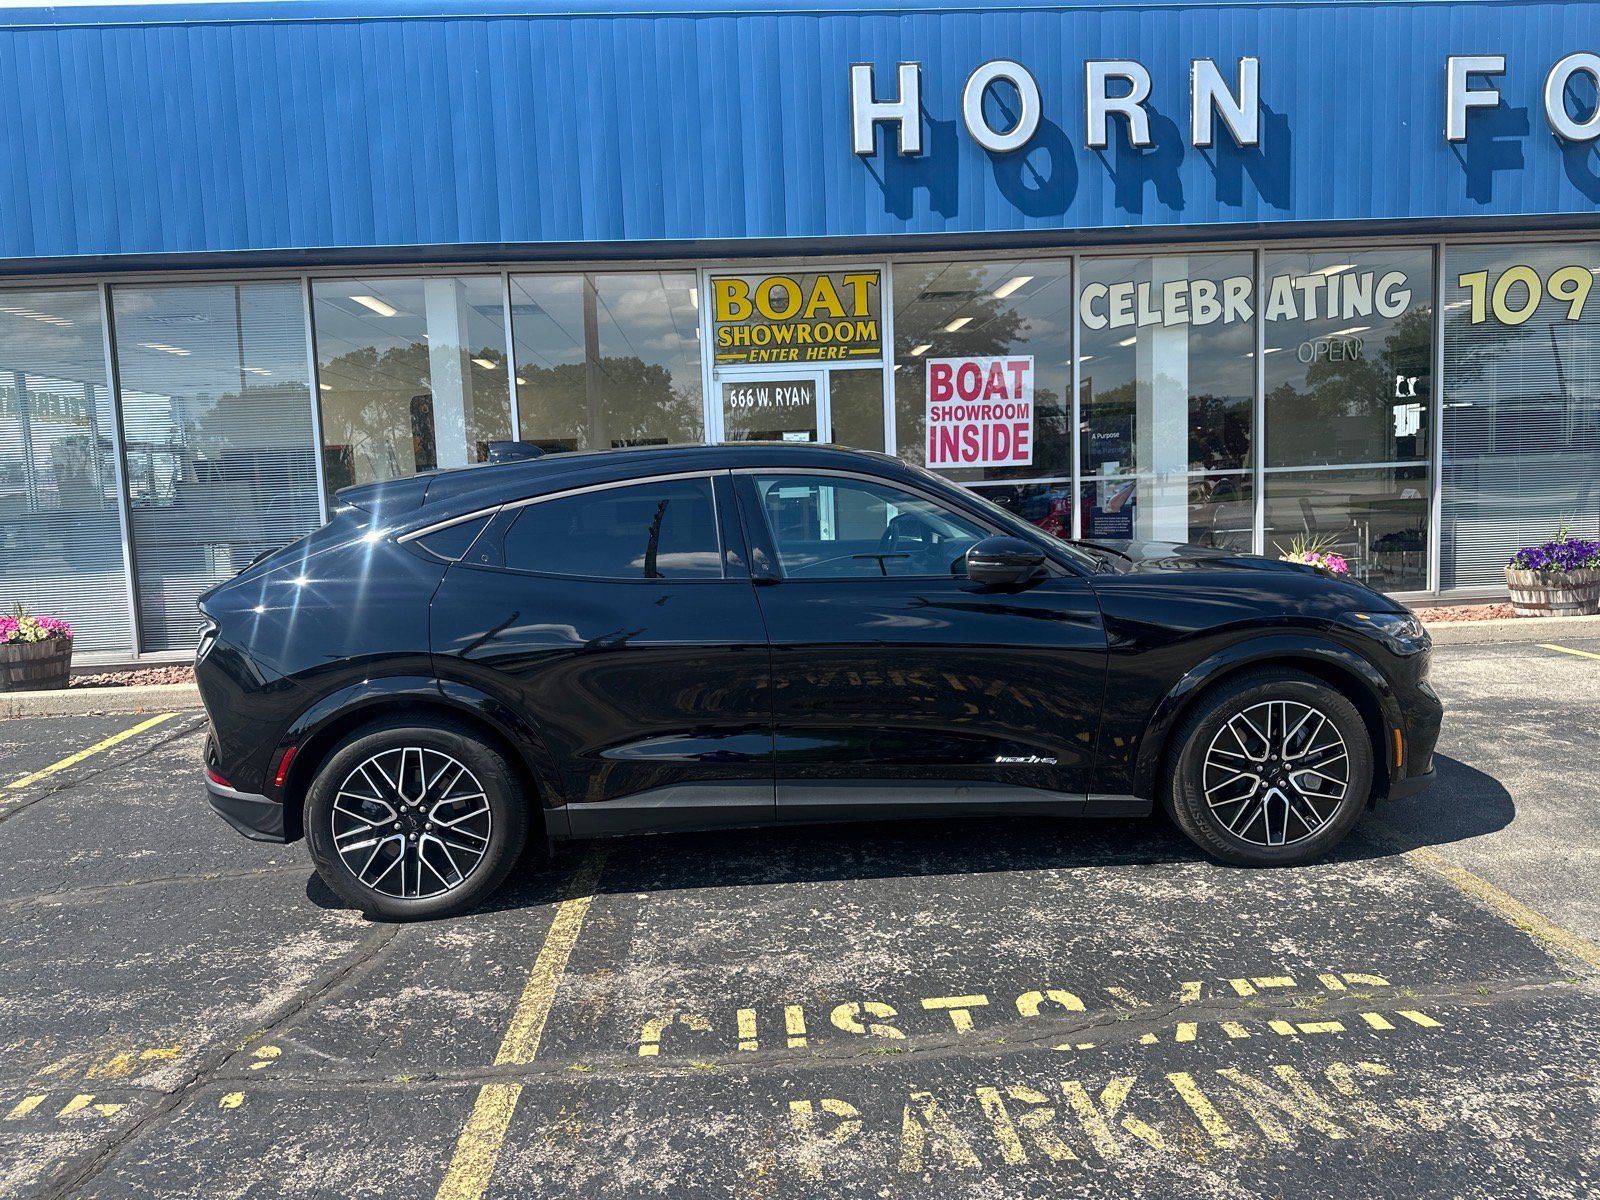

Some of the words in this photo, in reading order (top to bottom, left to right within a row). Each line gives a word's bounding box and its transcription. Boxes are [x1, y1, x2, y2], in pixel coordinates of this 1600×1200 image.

[849, 57, 1260, 157] HORN
[1445, 52, 1600, 143] FO
[712, 274, 880, 322] BOAT
[1080, 271, 1412, 330] CELEBRATING
[1458, 265, 1593, 326] 109
[717, 321, 879, 347] SHOWROOM
[749, 348, 799, 363] ENTER
[806, 346, 848, 361] HERE
[1299, 340, 1358, 363] OPEN
[929, 361, 1030, 402] BOAT
[730, 389, 754, 408] 666
[756, 387, 772, 407] W.
[775, 386, 810, 406] RYAN
[930, 403, 1030, 422] SHOWROOM
[929, 423, 1030, 463] INSIDE
[1097, 431, 1120, 440] Purpose
